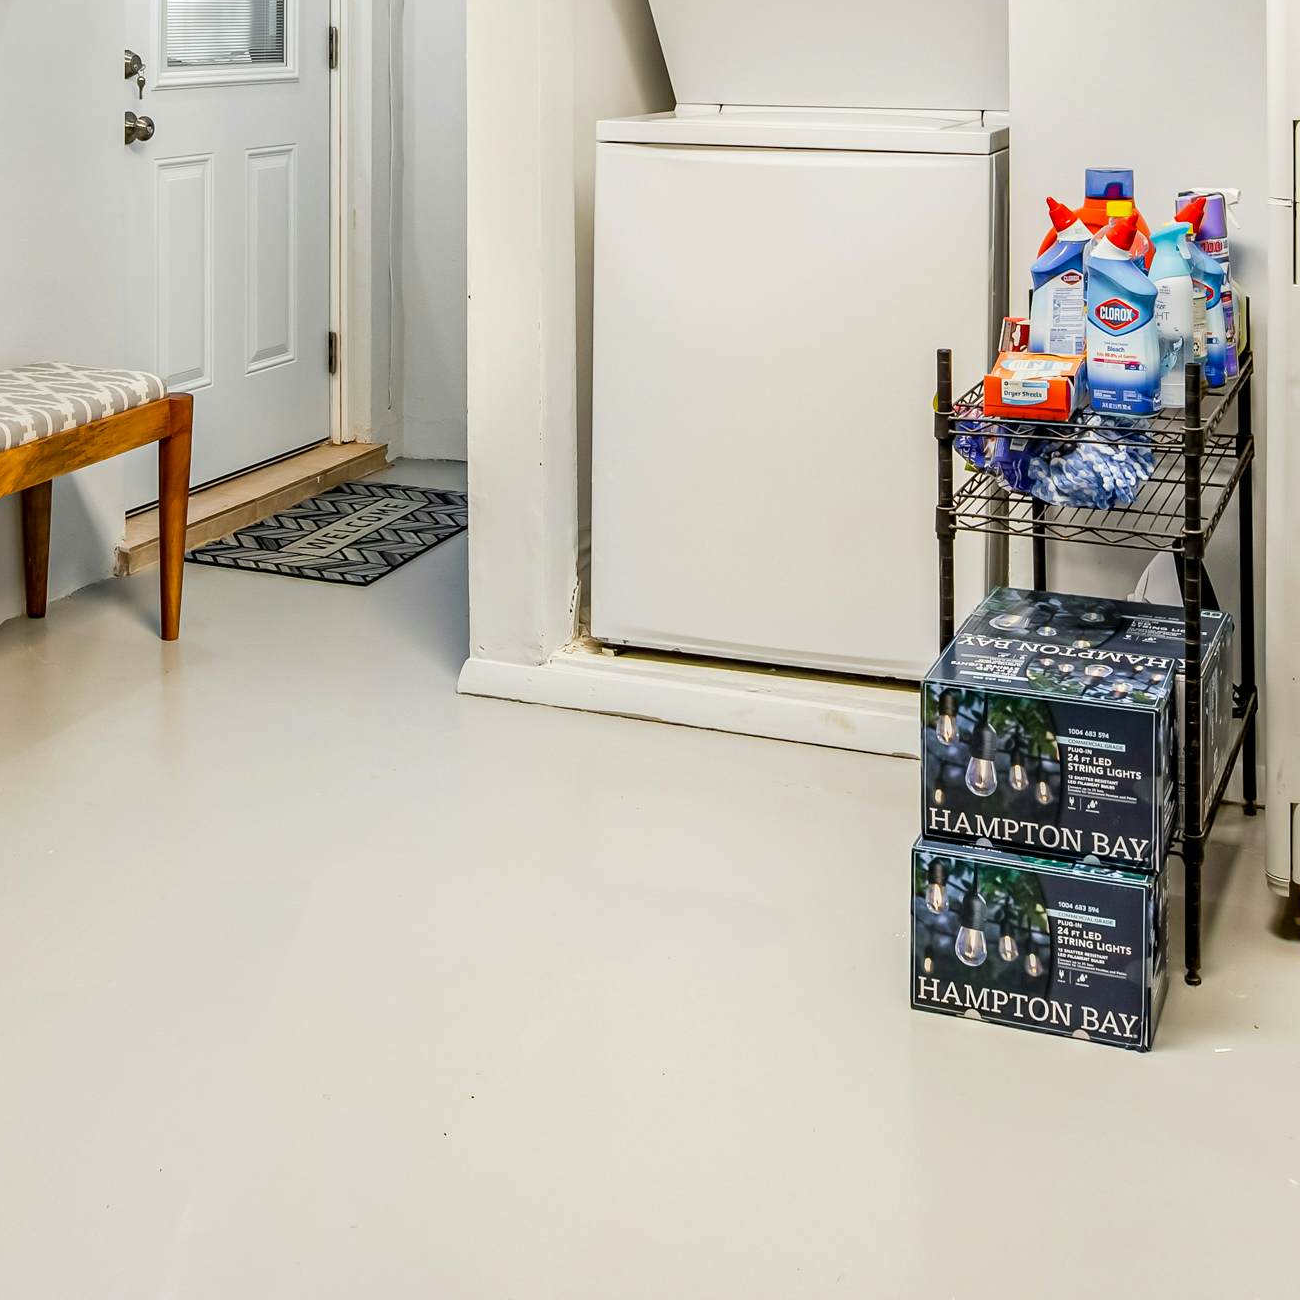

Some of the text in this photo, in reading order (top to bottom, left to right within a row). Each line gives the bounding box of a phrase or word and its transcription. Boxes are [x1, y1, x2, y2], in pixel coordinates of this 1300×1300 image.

[1100, 306, 1132, 322] CLOROX
[1004, 390, 1020, 398] Dryer
[298, 503, 409, 549] WELCOME
[957, 636, 1170, 668] HAMPTON BAY
[1068, 728, 1083, 736] 1004
[1068, 747, 1092, 755] PLUG-IN
[1067, 754, 1079, 762] 24
[1093, 757, 1112, 766] LED
[1067, 763, 1142, 780] STRING LIGHTS
[929, 808, 1149, 862] HAMPTON BAY
[1058, 901, 1073, 909] 1004
[1058, 919, 1082, 929] PLUG-IN
[1057, 926, 1102, 941] 24 FT LED
[1057, 936, 1132, 955] STRING LIGHTS
[917, 976, 1139, 1038] HAMPTON BAY
